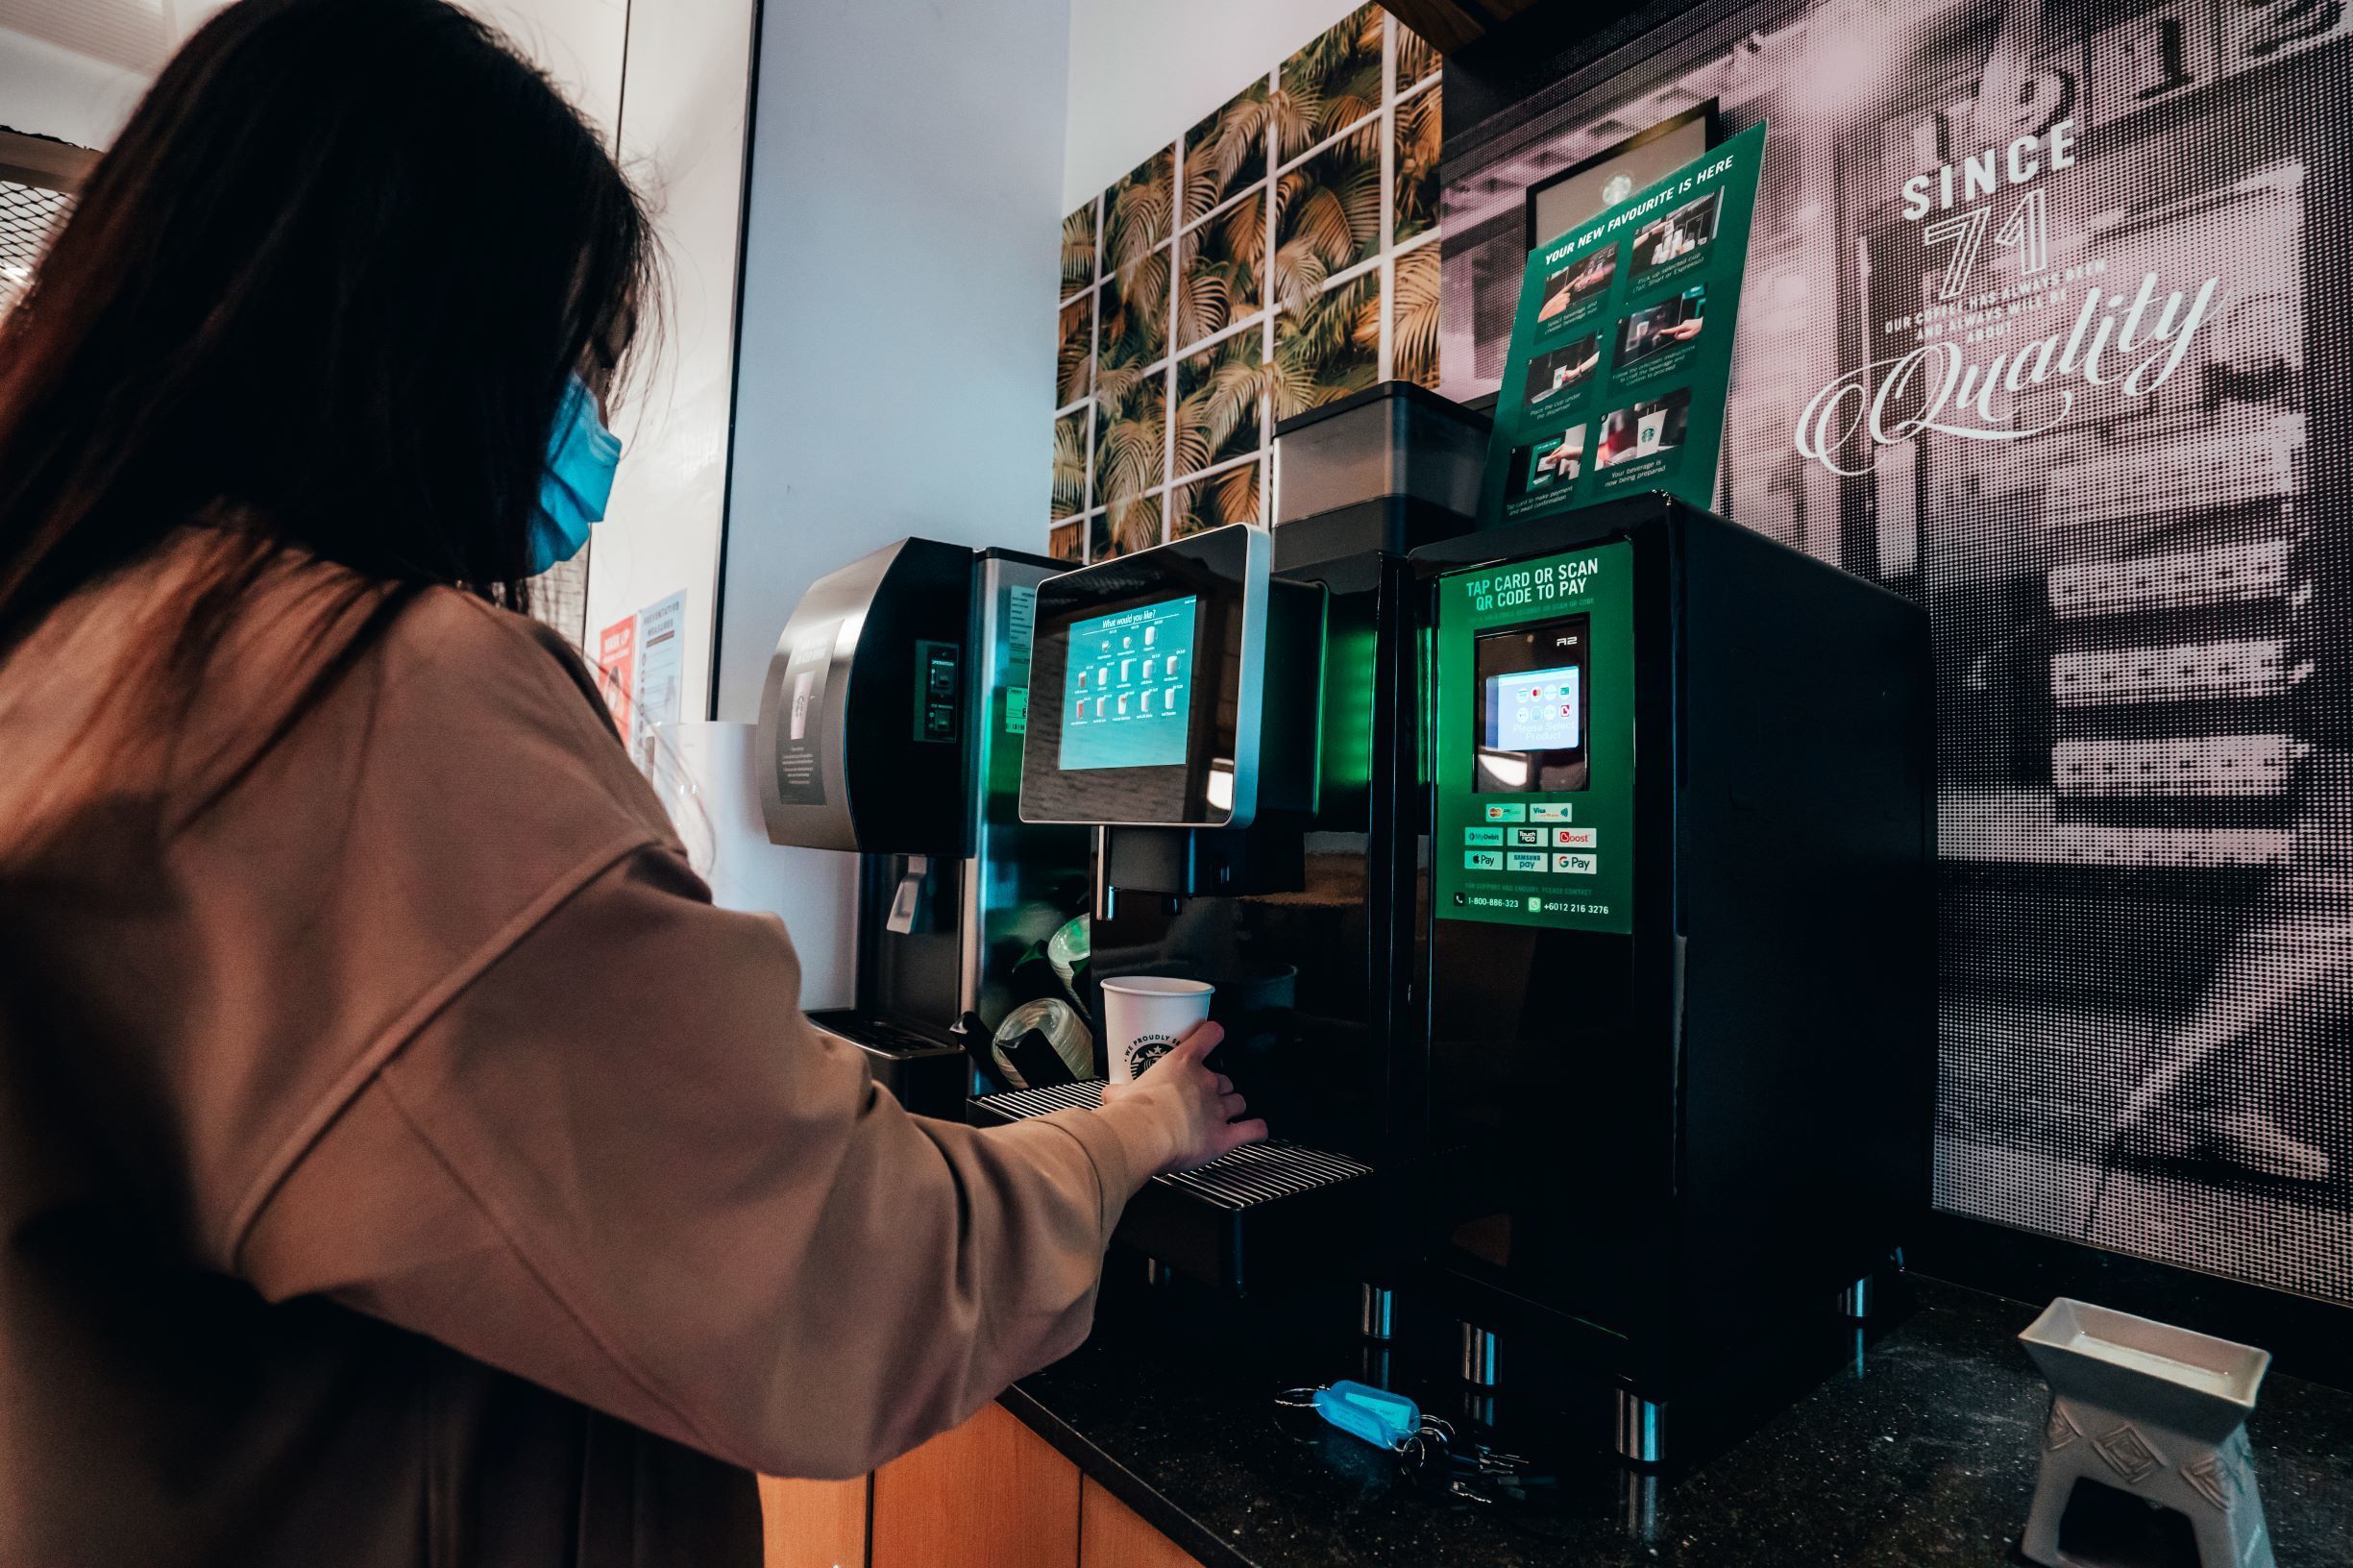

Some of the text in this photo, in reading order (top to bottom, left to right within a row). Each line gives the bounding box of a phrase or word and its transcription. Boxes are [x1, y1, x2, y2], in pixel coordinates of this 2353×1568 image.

[1902, 118, 2074, 221] SINCE
[1545, 155, 1734, 265] YOUR NEW FAVOURITE IS HERE
[1924, 187, 2047, 301] 71
[1662, 258, 1687, 273] selected
[1688, 252, 1701, 261] cup
[1884, 259, 2106, 333] OUR COFFEE HAS ALWAYS BEEN
[1563, 307, 1585, 321] beverage
[1587, 301, 1597, 309] and
[1563, 312, 1585, 327] beverage
[1918, 322, 1943, 340] AND
[1949, 306, 2002, 332] ALWAYS
[2008, 296, 2043, 315] WILL
[1967, 320, 2013, 343] ABOUT
[1649, 360, 1673, 372] beverage
[1795, 272, 2232, 477] Quality
[1565, 393, 1580, 404] under
[1618, 475, 1635, 483] being
[1637, 465, 1666, 478] prepared
[1626, 461, 1654, 474] beverage
[1534, 495, 1566, 508] confirmation
[1550, 486, 1574, 498] payment
[1466, 557, 1599, 597] TAP CARD OR SCAN
[1476, 577, 1587, 611] QR CODE TO PAY
[1103, 618, 1115, 628] What
[1116, 613, 1132, 626] would
[1133, 613, 1142, 625] you
[1143, 609, 1156, 620] like?
[1481, 855, 1494, 867] Pay
[1572, 857, 1590, 870] Pay
[1468, 896, 1608, 915] 1-800-886-323 +6012 216 3276
[1125, 1045, 1133, 1056] WE
[1133, 1034, 1170, 1045] PROUDLY
